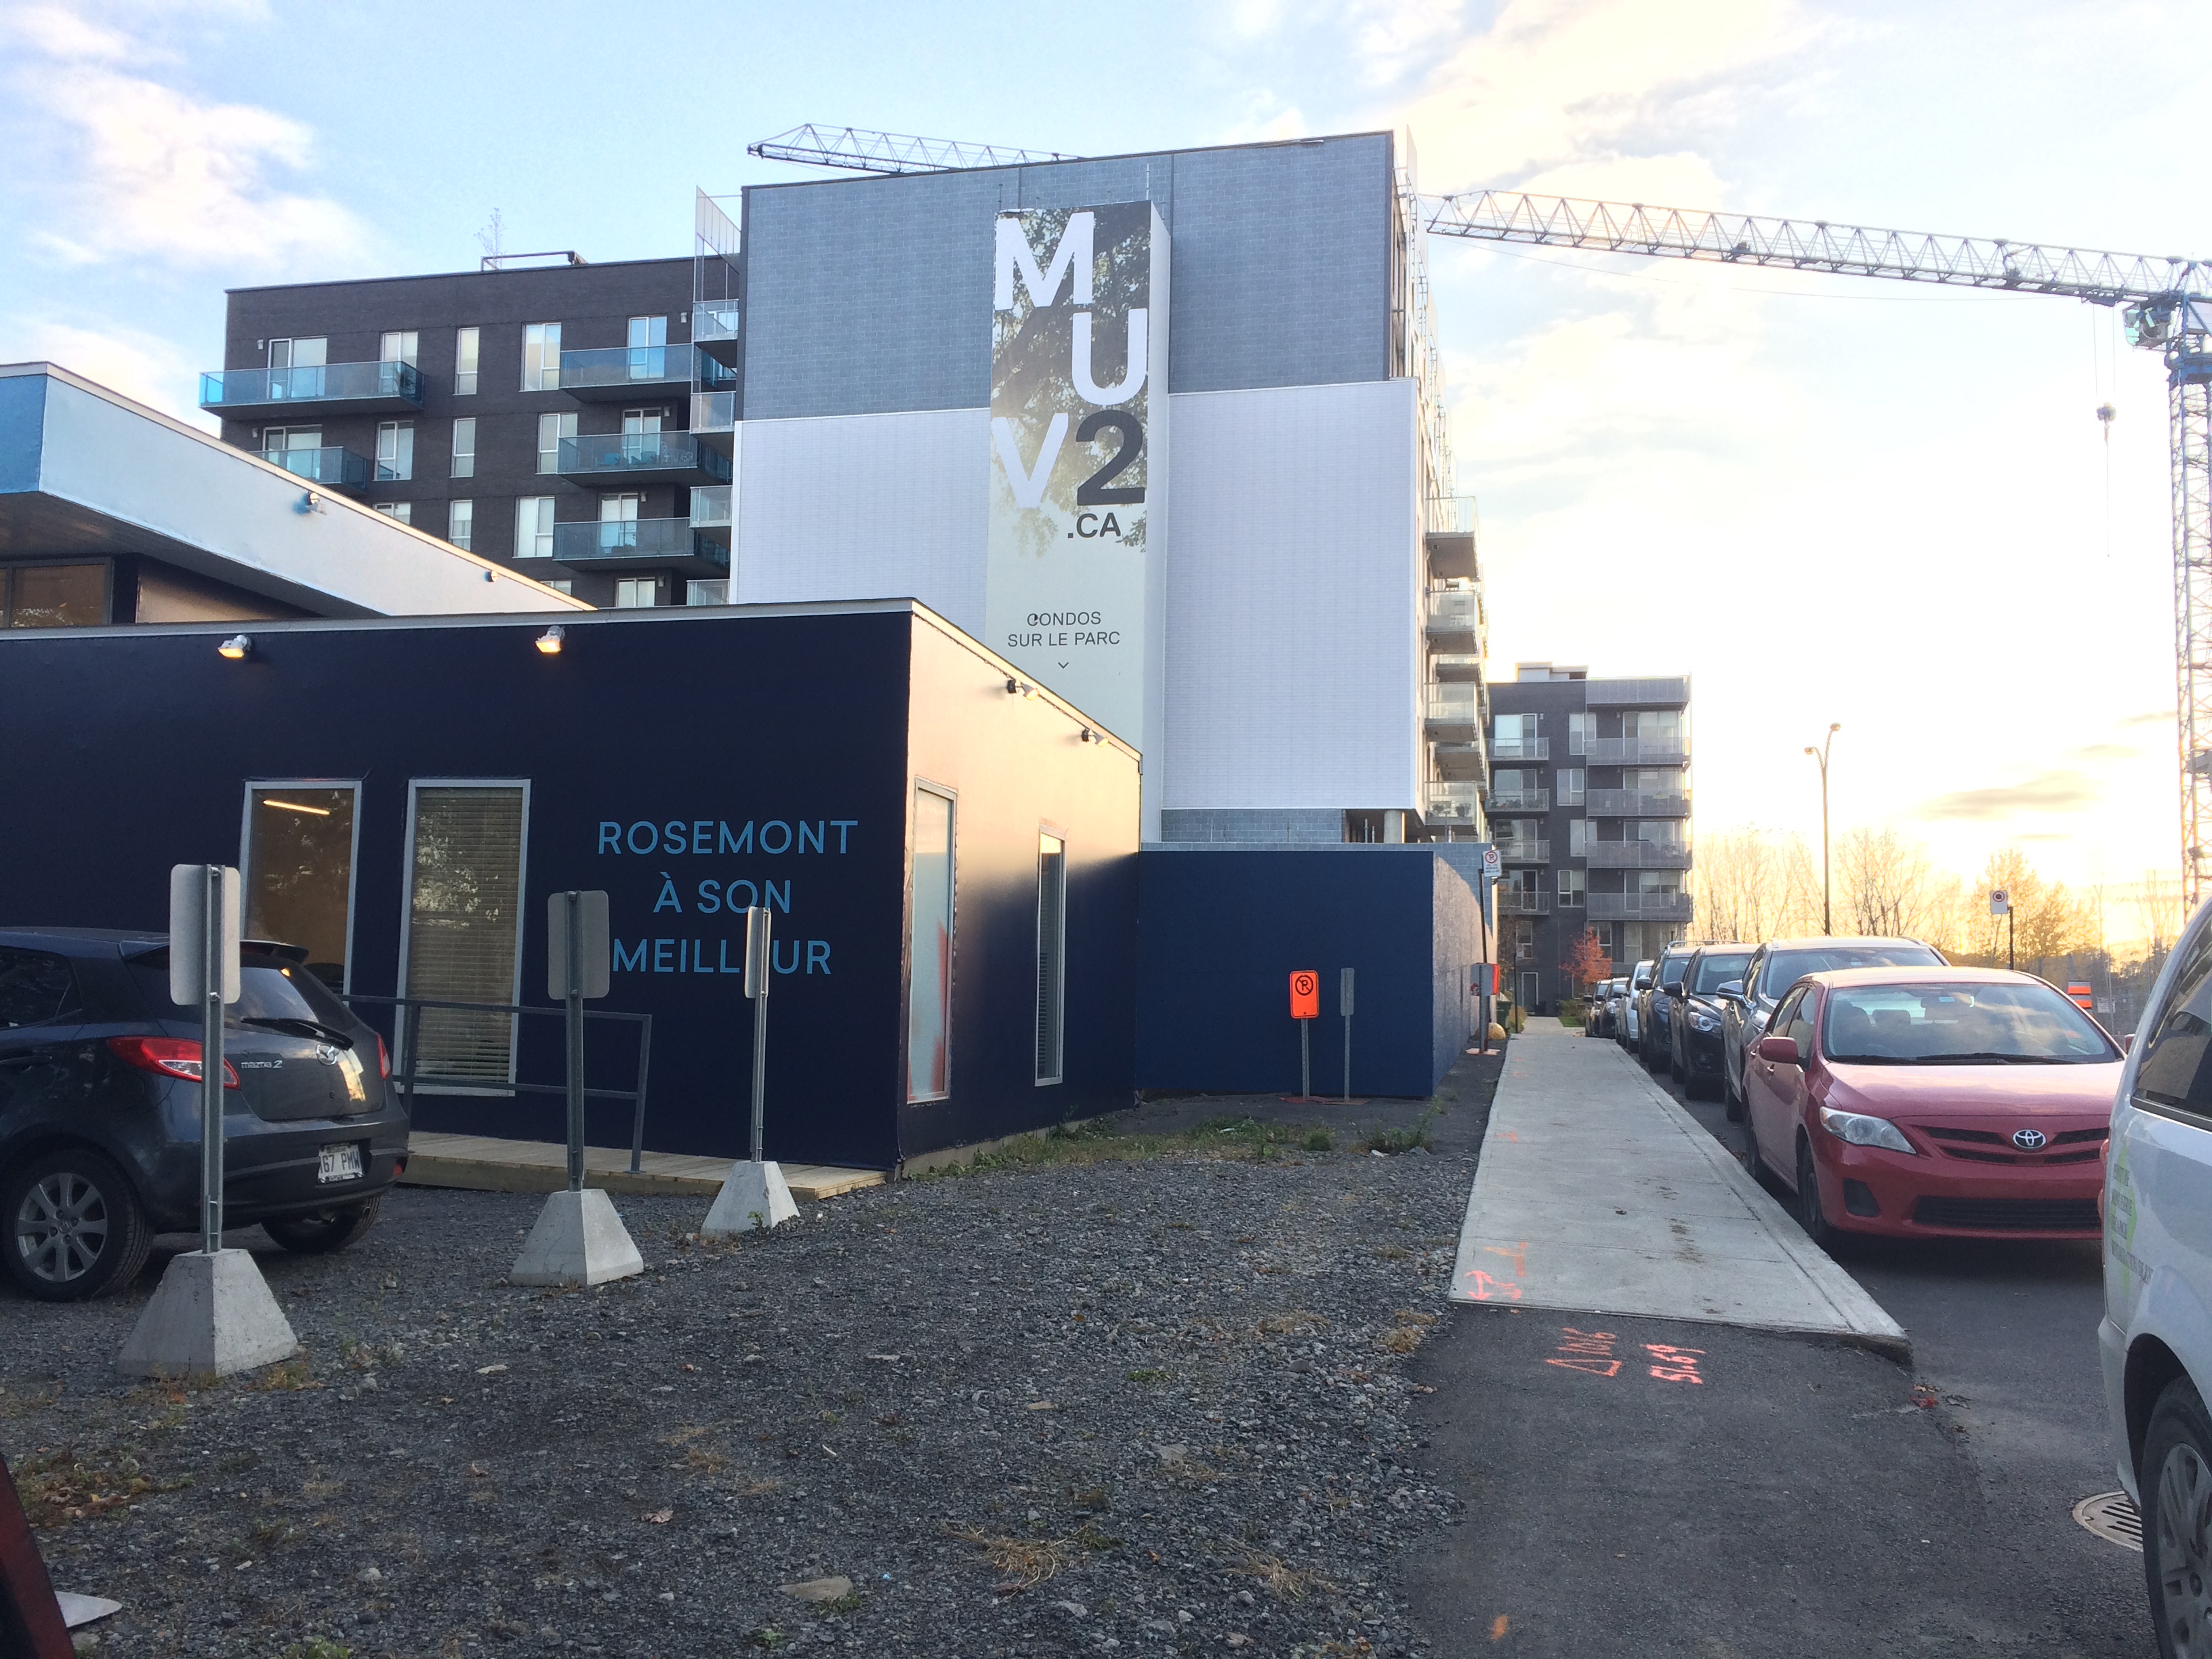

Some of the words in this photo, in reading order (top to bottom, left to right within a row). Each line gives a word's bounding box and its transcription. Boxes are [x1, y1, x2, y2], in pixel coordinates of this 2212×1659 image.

[1067, 512, 1122, 539] .CA
[1027, 611, 1102, 627] CONDOS
[1007, 633, 1042, 647] SUR
[1048, 632, 1068, 647] LE
[1074, 631, 1120, 646] PARC
[598, 819, 859, 855] ROSEMONT
[653, 871, 683, 914] À
[697, 879, 792, 914] SON
[612, 938, 832, 975] MEILLUR
